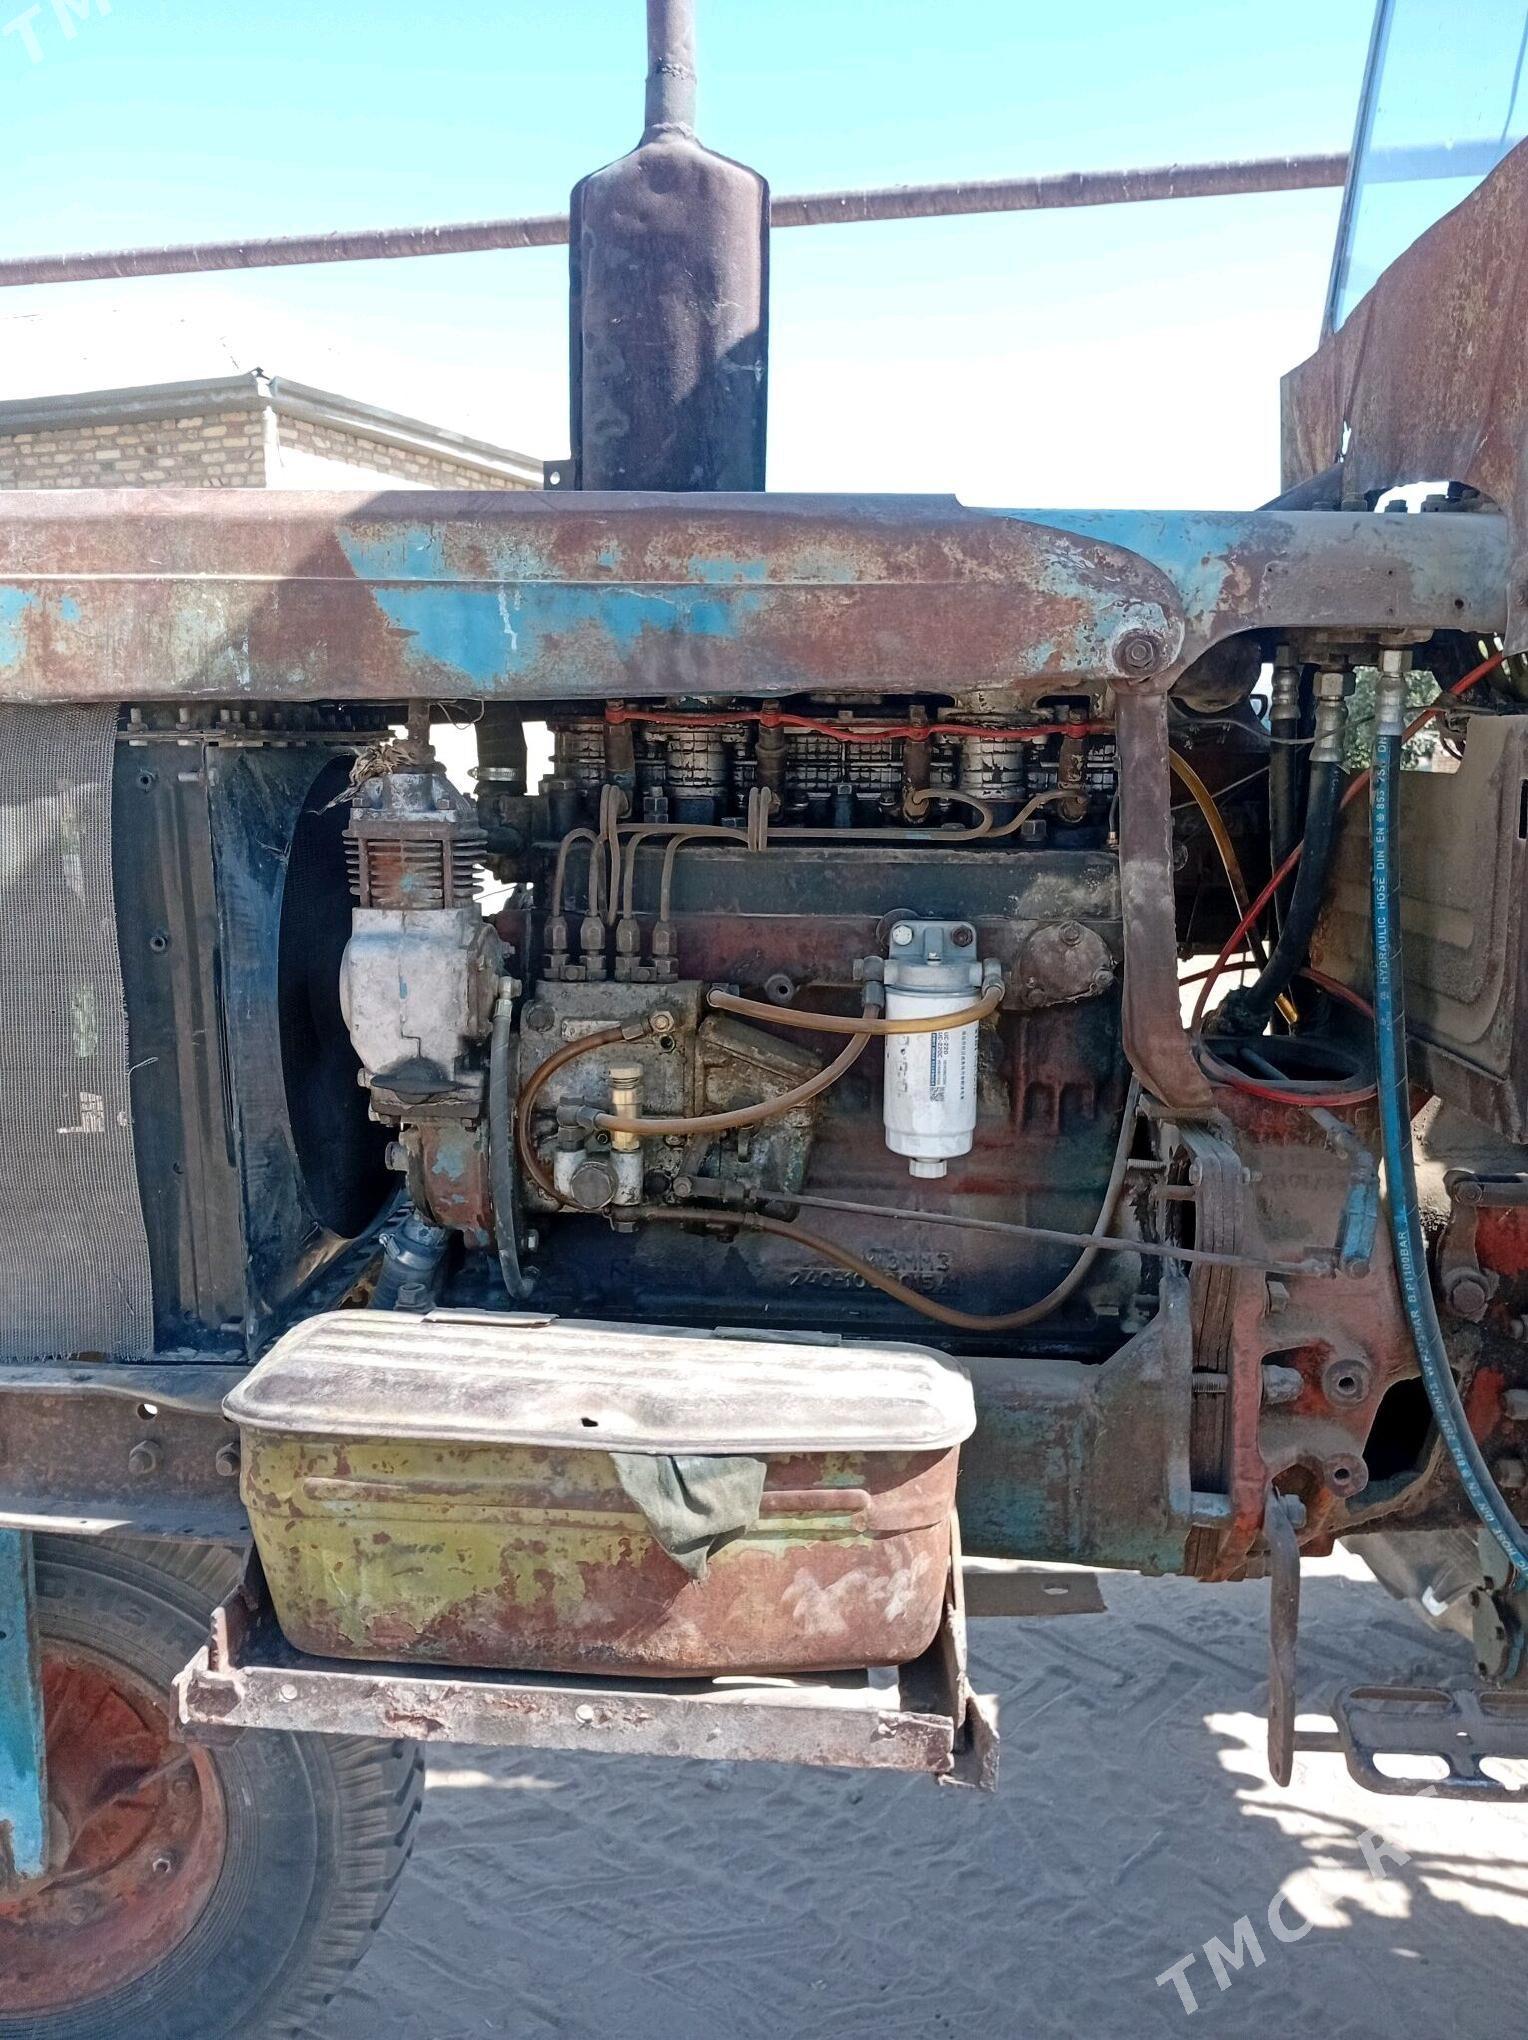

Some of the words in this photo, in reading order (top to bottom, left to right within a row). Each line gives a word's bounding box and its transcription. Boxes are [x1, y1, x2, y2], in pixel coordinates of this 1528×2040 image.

[1375, 827, 1386, 843] EN
[1376, 850, 1386, 871] DIN
[1376, 877, 1387, 910] HOSE
[1377, 917, 1389, 984] HYDRAULIC
